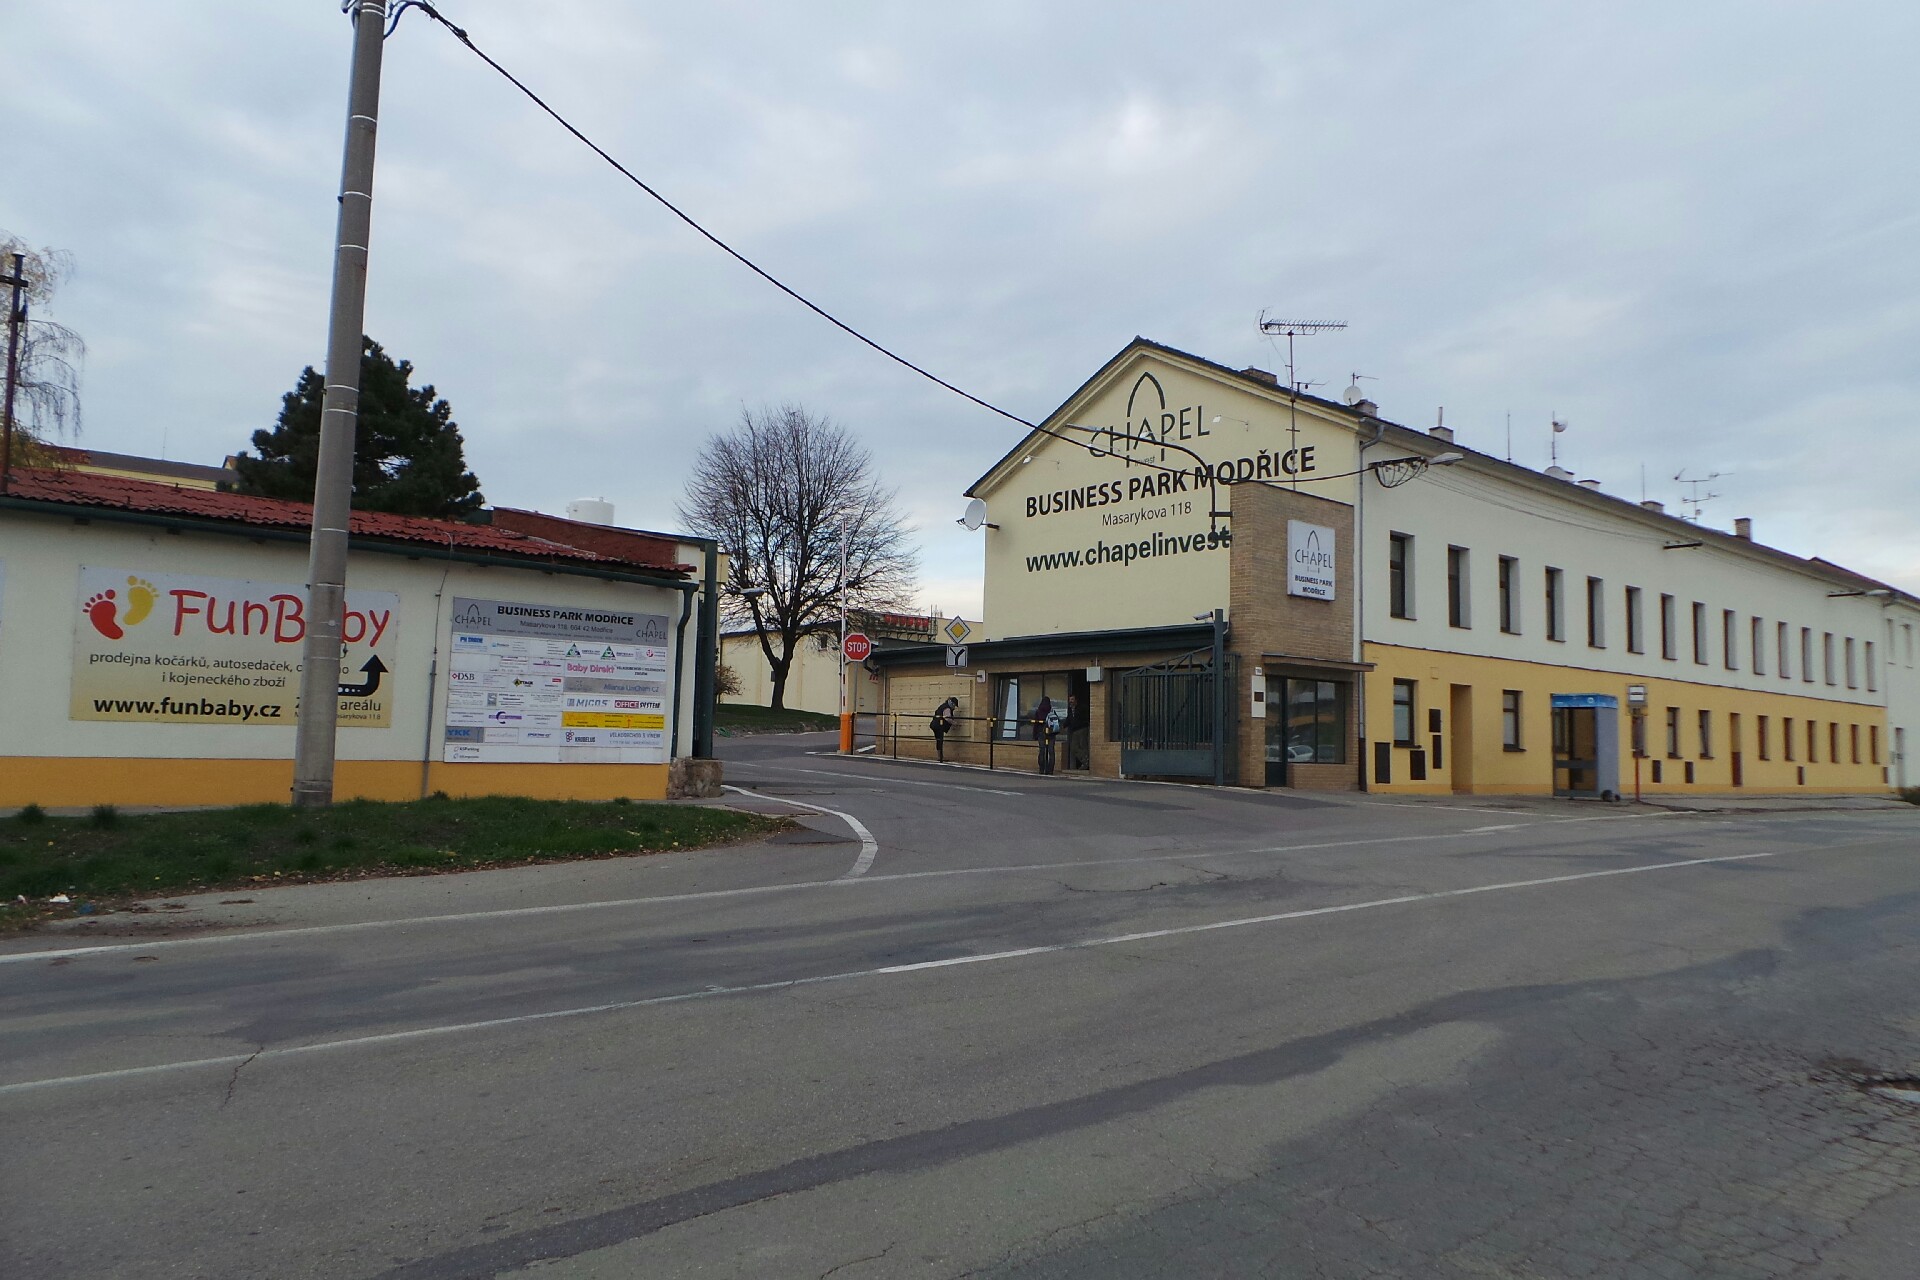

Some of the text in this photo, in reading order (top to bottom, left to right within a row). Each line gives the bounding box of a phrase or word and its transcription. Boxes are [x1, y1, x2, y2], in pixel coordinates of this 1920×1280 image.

[1089, 405, 1211, 460] CHAPEL
[1025, 445, 1316, 518] BUSINESS PARK MODŘICE
[1102, 501, 1192, 527] Masarykova 118
[1294, 549, 1333, 569] CHAPEL
[1294, 574, 1333, 587] BUSINESS PARK
[1302, 586, 1326, 596] MODŘICE
[168, 588, 391, 648] FunBby
[454, 614, 492, 627] CHAPEL
[497, 605, 634, 626] BUSINESS PARK MODŘICE
[520, 620, 556, 630] Masarykova
[636, 629, 667, 641] CHAPEL
[847, 641, 868, 653] STOP
[89, 652, 151, 669] prodejna
[154, 654, 210, 671] kočárků,
[213, 657, 293, 673] autosedaček,
[566, 663, 615, 674] Baby Direkt
[162, 672, 286, 688] i kojeneckého zboží
[457, 673, 475, 681] DSB
[93, 697, 281, 720] www.funbaby.cz
[340, 699, 382, 712] areálu
[576, 699, 609, 707] MICOS
[615, 700, 639, 708] OFFICE
[369, 713, 381, 721] 118
[448, 729, 471, 737] YKK
